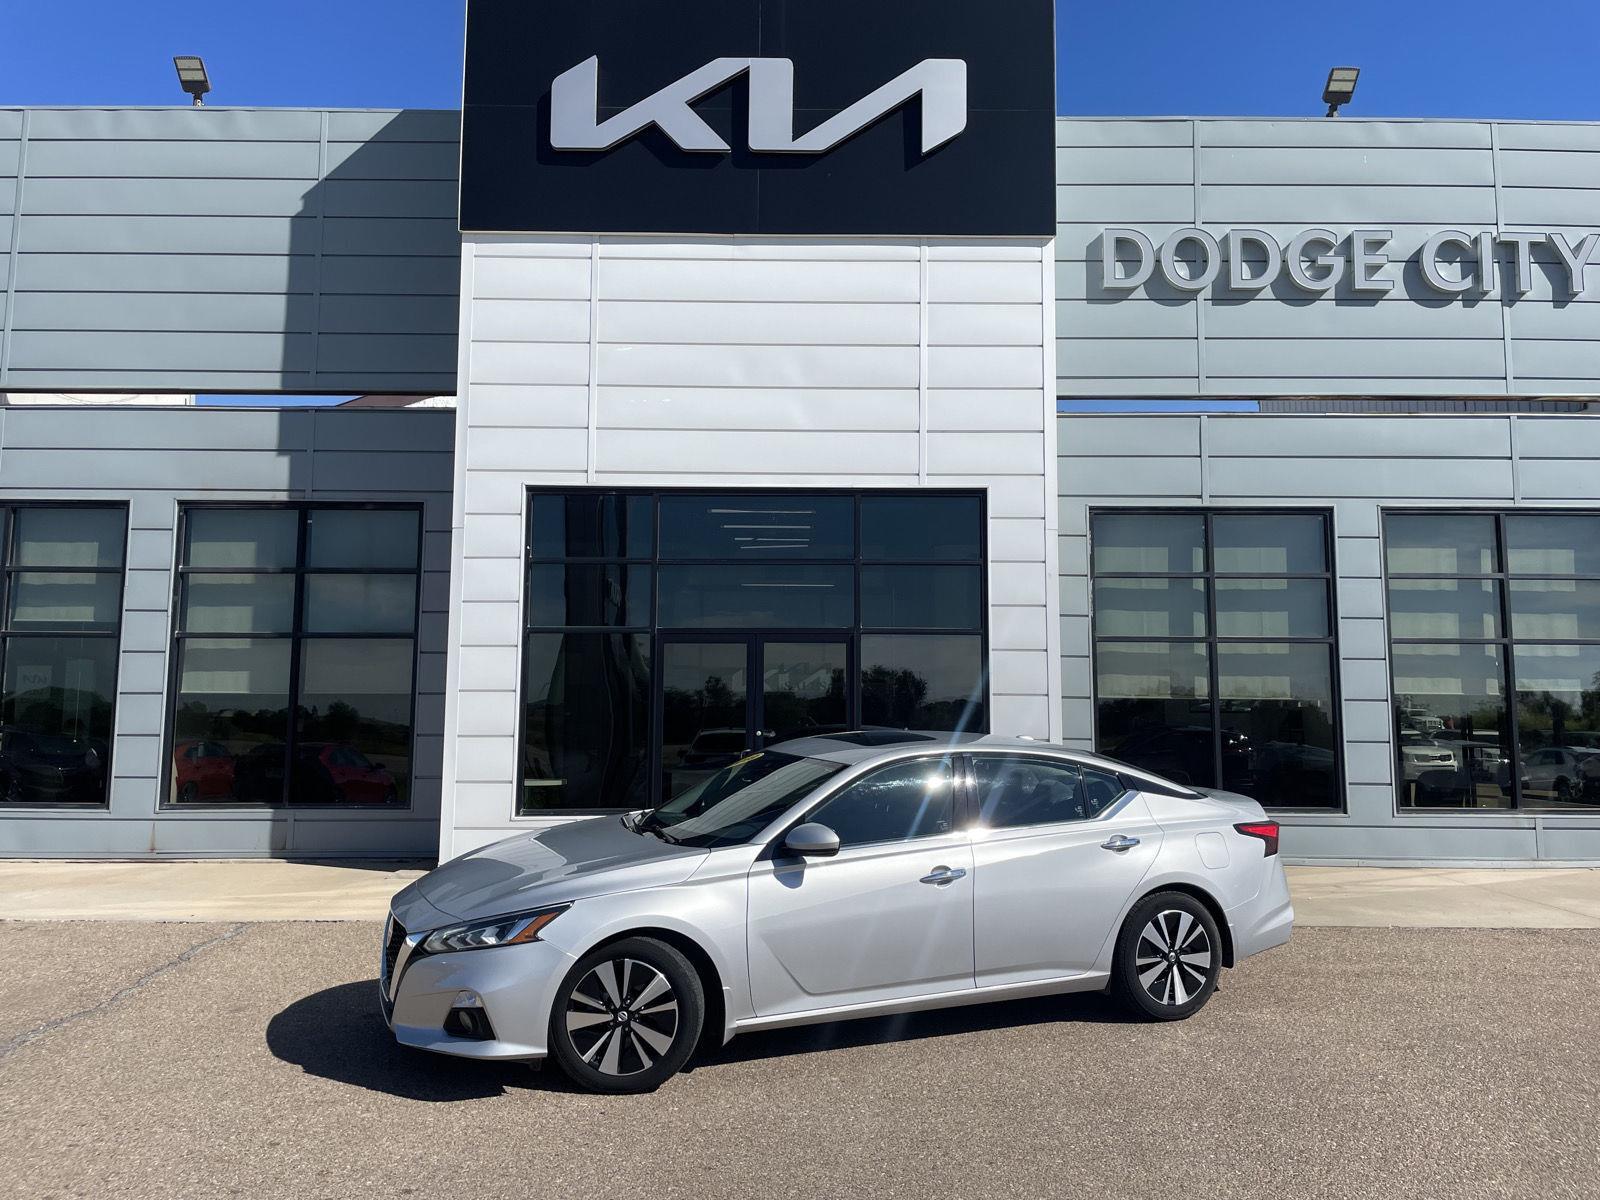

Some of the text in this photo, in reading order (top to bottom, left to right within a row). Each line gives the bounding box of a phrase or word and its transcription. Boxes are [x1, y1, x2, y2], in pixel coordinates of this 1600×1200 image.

[550, 55, 967, 155] KIA
[1102, 227, 1600, 293] DODGE CITY
